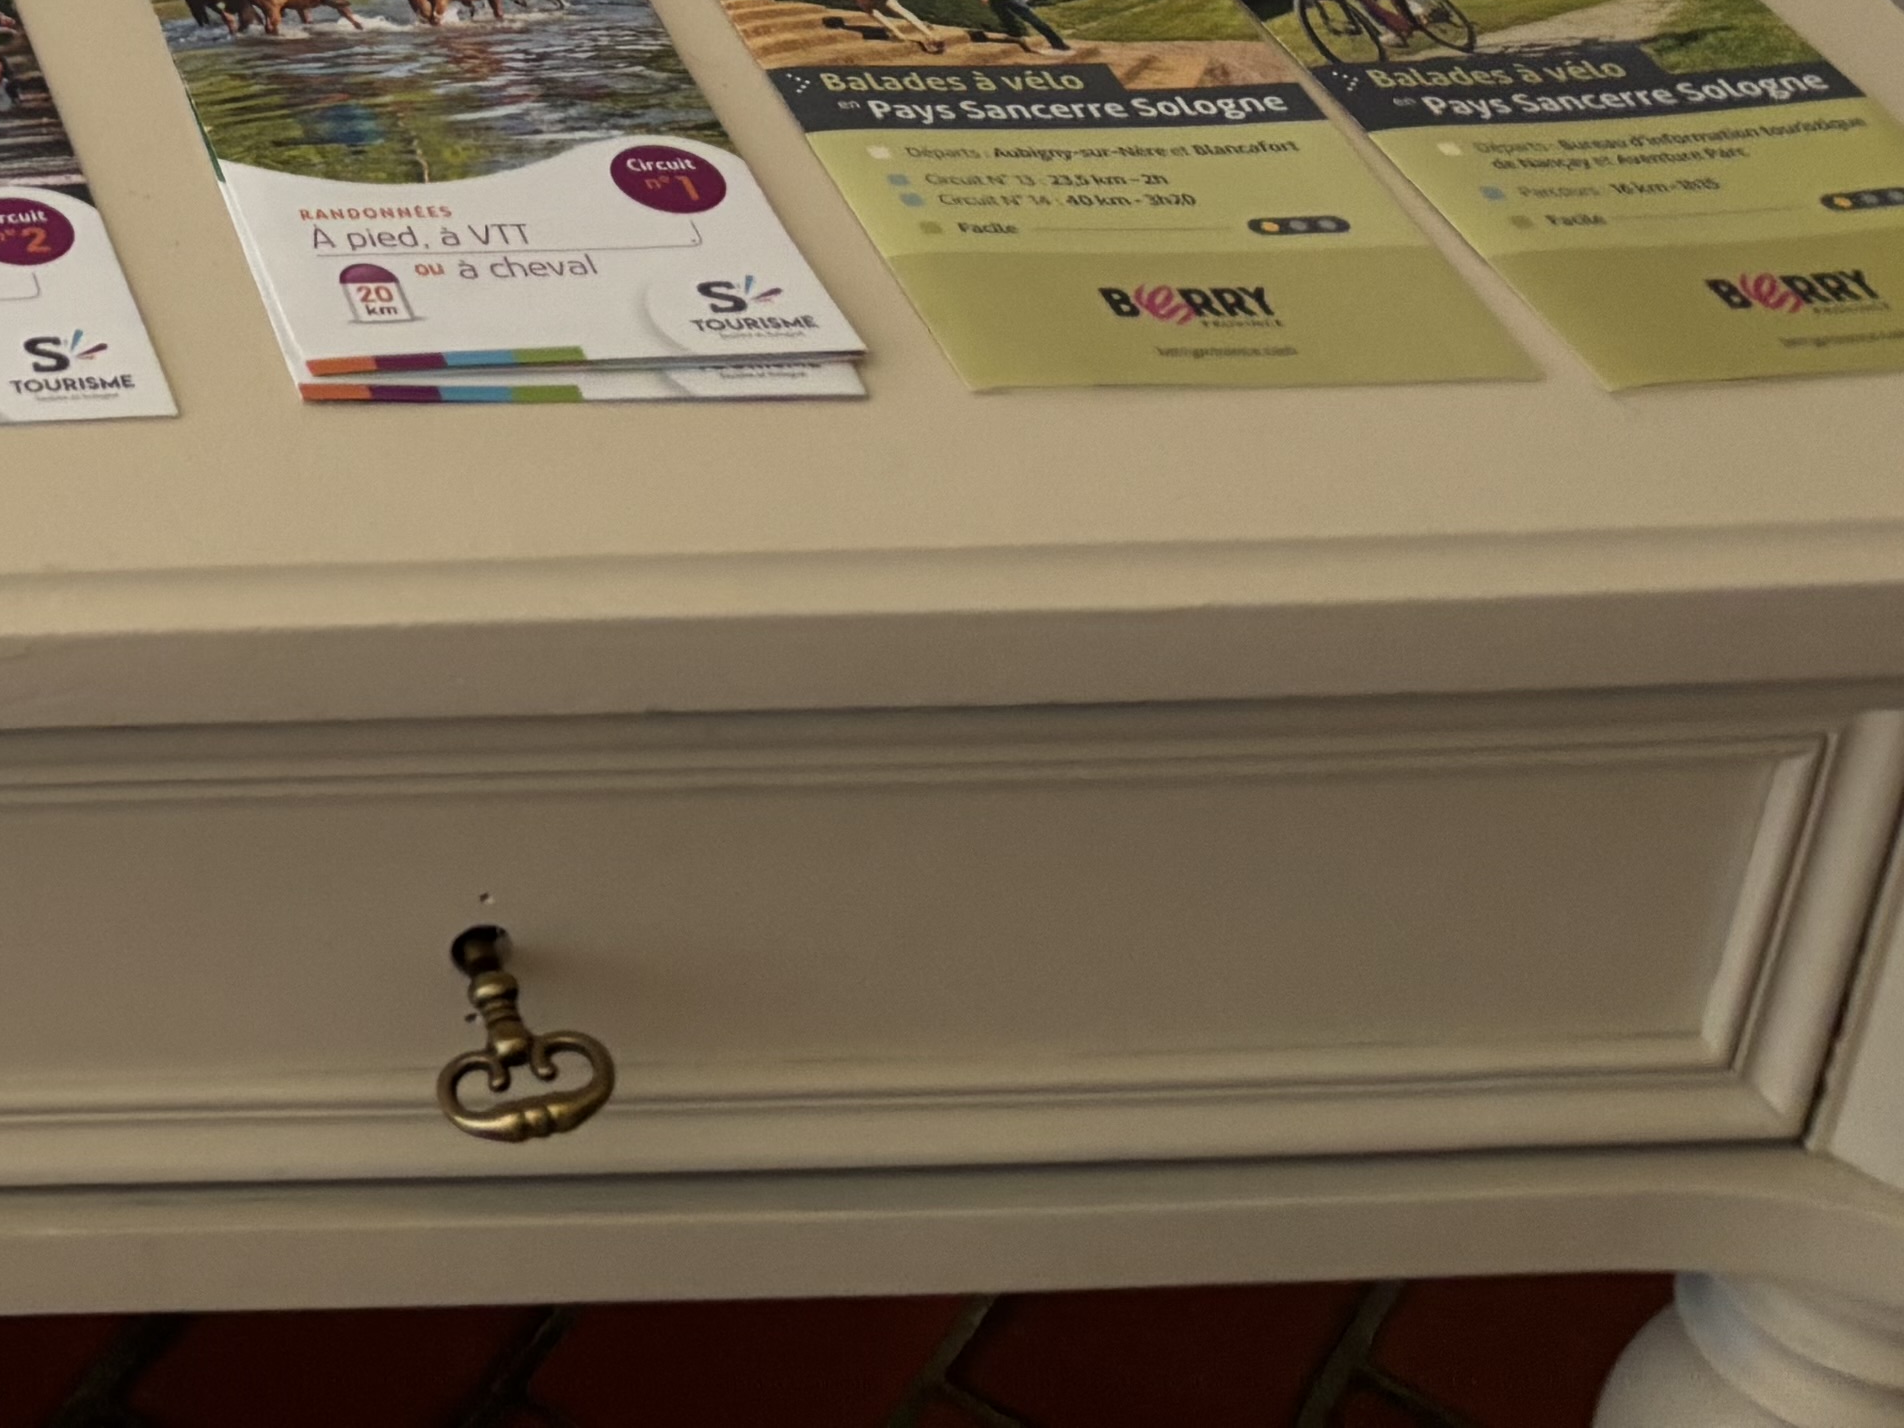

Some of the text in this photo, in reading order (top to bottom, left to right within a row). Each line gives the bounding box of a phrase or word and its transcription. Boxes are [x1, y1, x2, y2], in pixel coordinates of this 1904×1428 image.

[823, 71, 1085, 94] Balades à vélo
[1423, 72, 1830, 121] Pays Sancerre Sologne
[869, 99, 954, 125] Pays
[959, 99, 1126, 120] Sancerre
[1131, 92, 1289, 121] Sologne
[627, 157, 696, 173] Circuit
[676, 176, 700, 201] 1
[957, 221, 1019, 236] Facile
[23, 227, 51, 253] 2
[356, 286, 393, 304] 20
[366, 304, 398, 317] km
[689, 314, 819, 333] TOURISME
[9, 374, 136, 393] TOURISME
